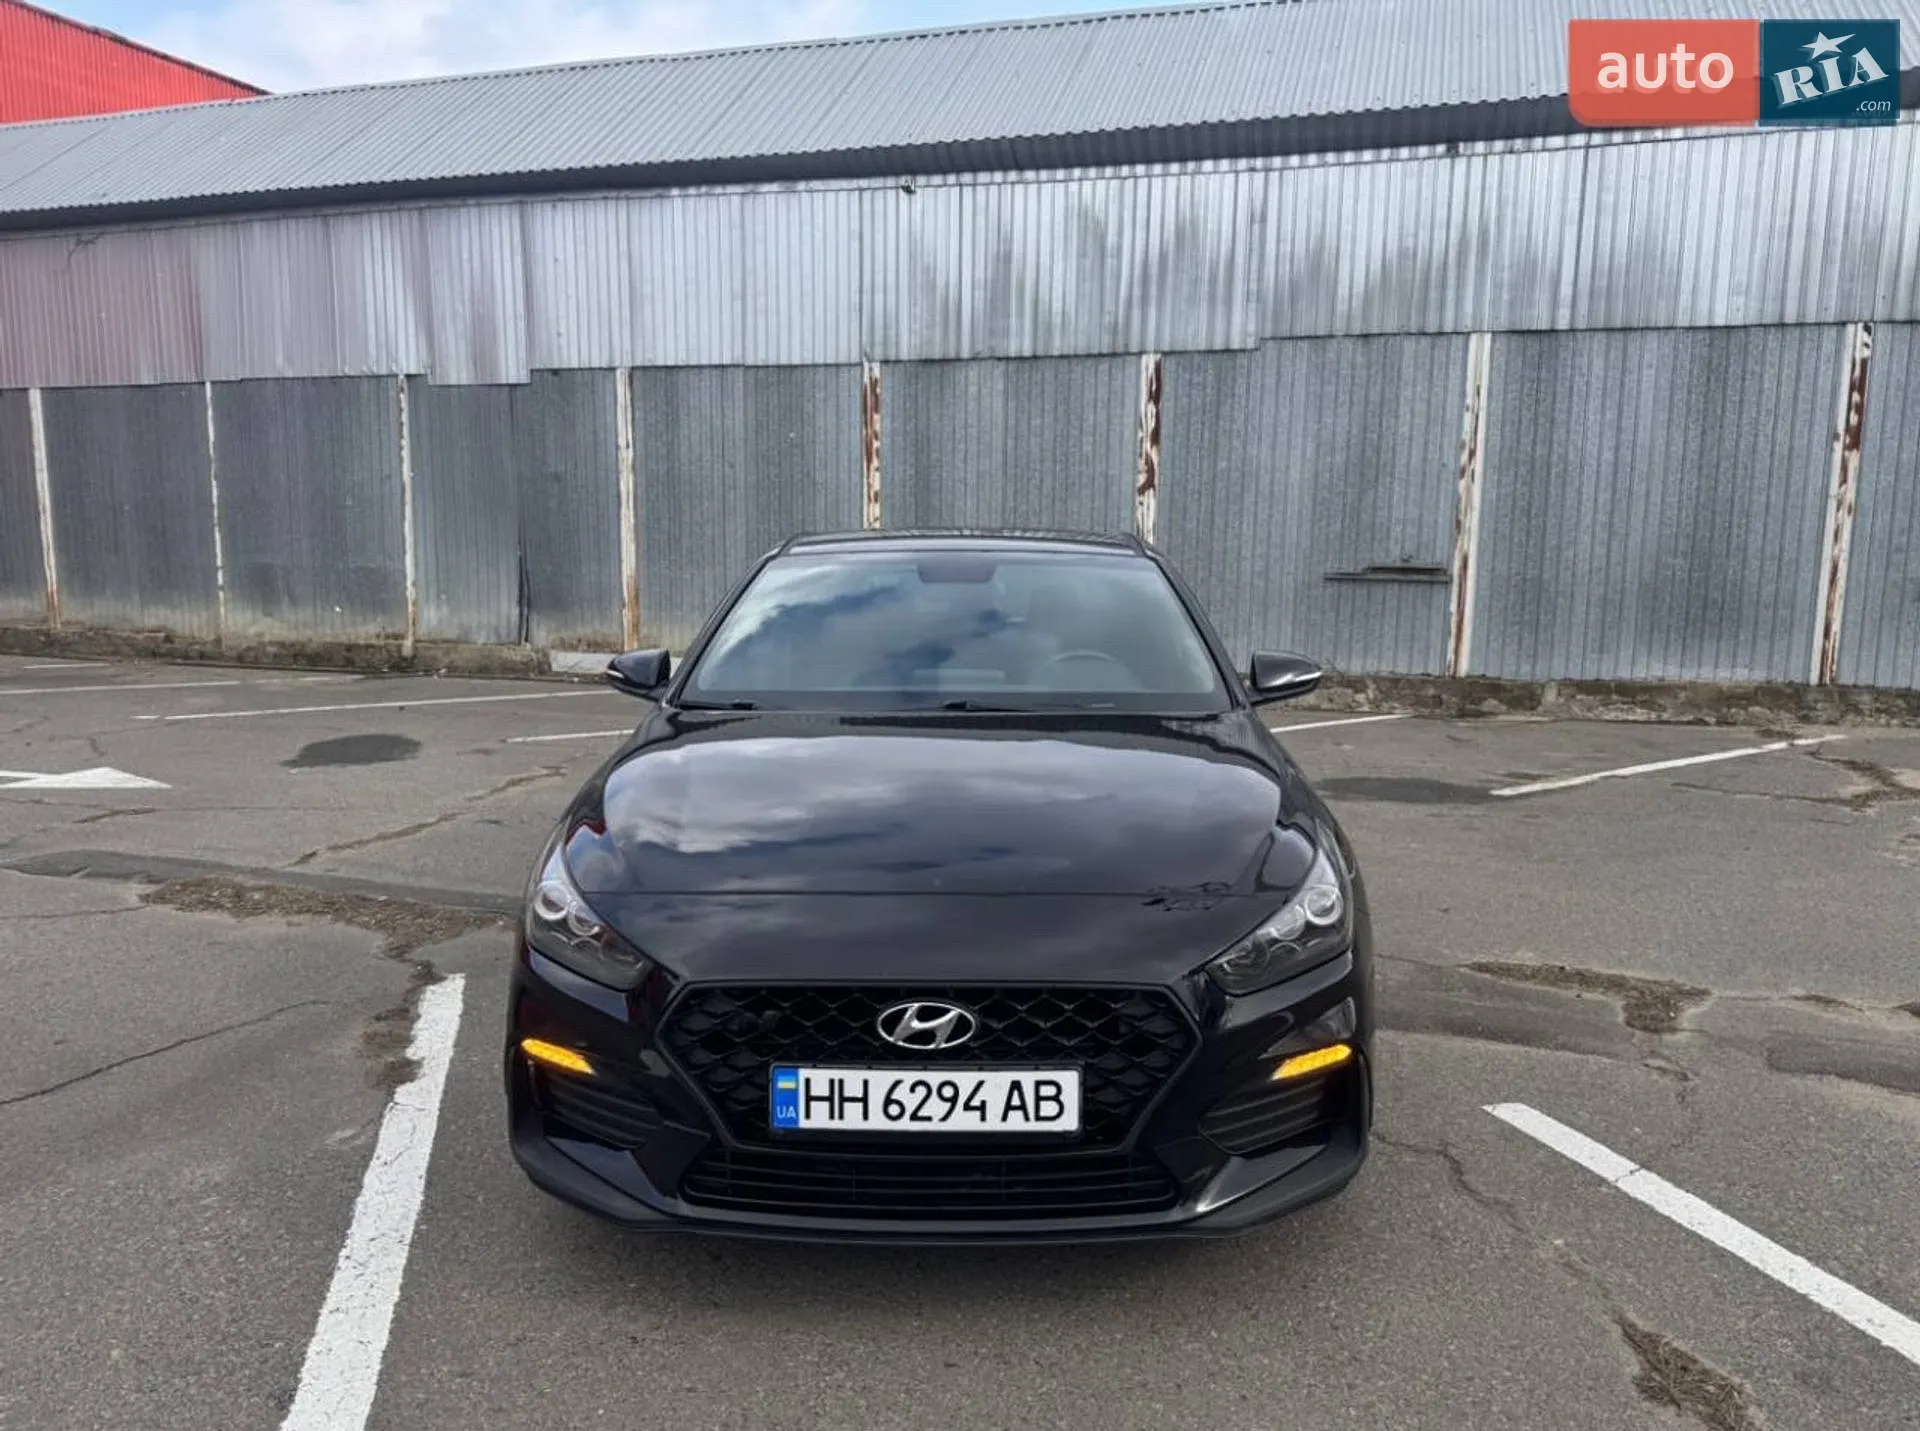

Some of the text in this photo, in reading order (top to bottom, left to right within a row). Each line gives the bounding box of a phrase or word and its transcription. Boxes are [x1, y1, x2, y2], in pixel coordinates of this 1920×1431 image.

[776, 1106, 797, 1118] UA
[804, 1077, 1065, 1122] HH 6294 AB
